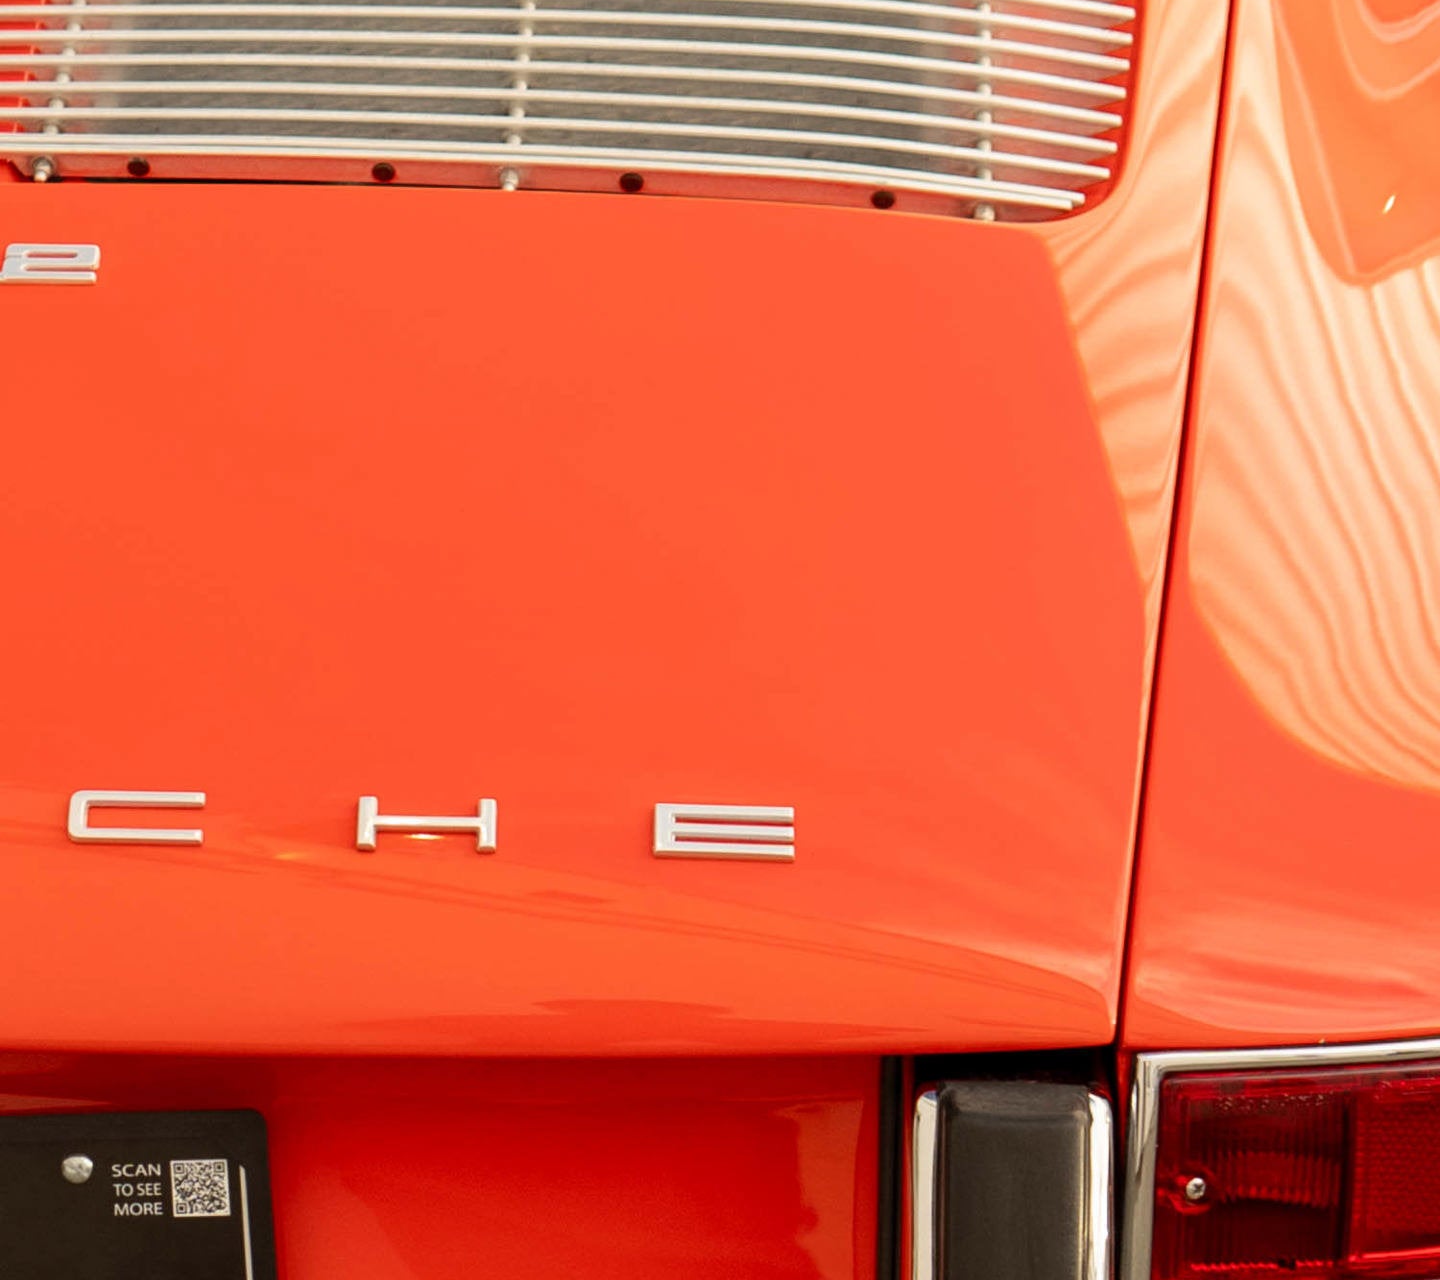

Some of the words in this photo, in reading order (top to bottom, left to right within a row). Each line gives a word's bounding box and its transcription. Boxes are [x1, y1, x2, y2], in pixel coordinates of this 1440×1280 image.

[111, 1163, 162, 1178] SCAN
[112, 1183, 134, 1197] TO
[136, 1182, 162, 1196] SEE
[113, 1202, 164, 1216] MORE
